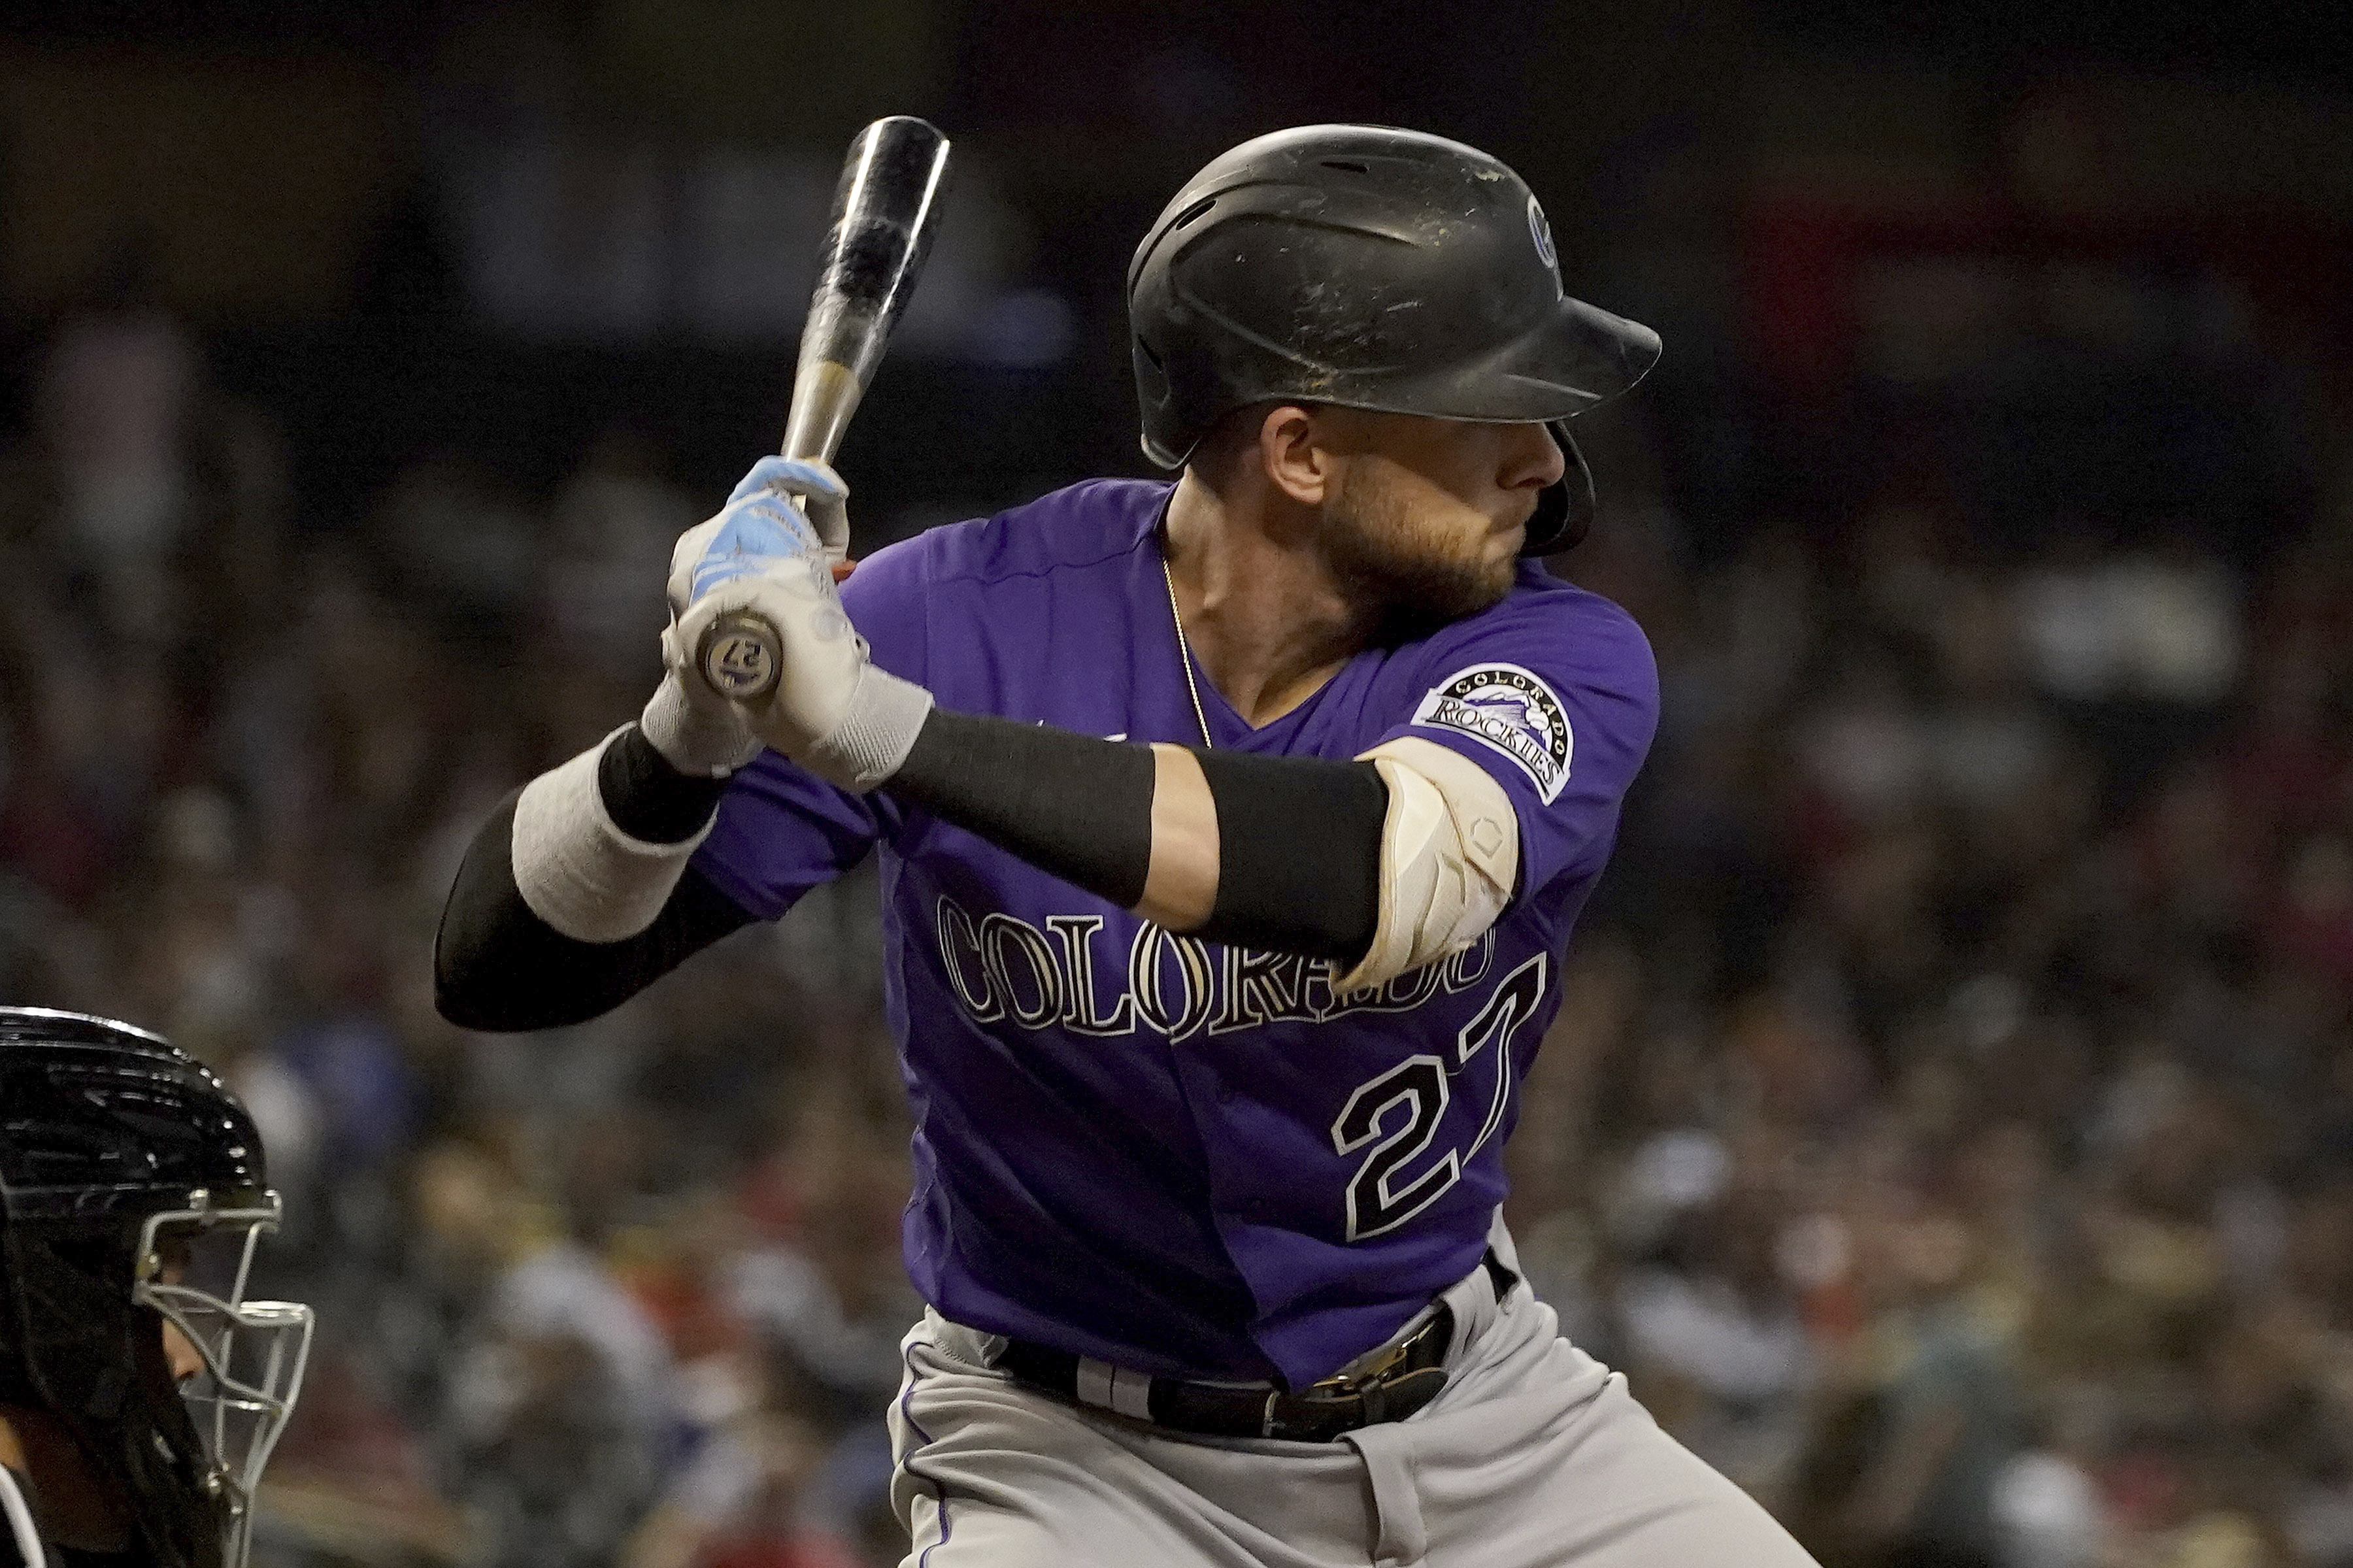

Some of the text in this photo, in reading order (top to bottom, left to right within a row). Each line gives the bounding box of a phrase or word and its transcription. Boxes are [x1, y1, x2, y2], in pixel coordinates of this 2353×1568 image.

[722, 639, 761, 667] 27
[1429, 699, 1560, 784] ROCKIES
[1456, 671, 1565, 755] COLORADO
[1331, 951, 1547, 1241] 27
